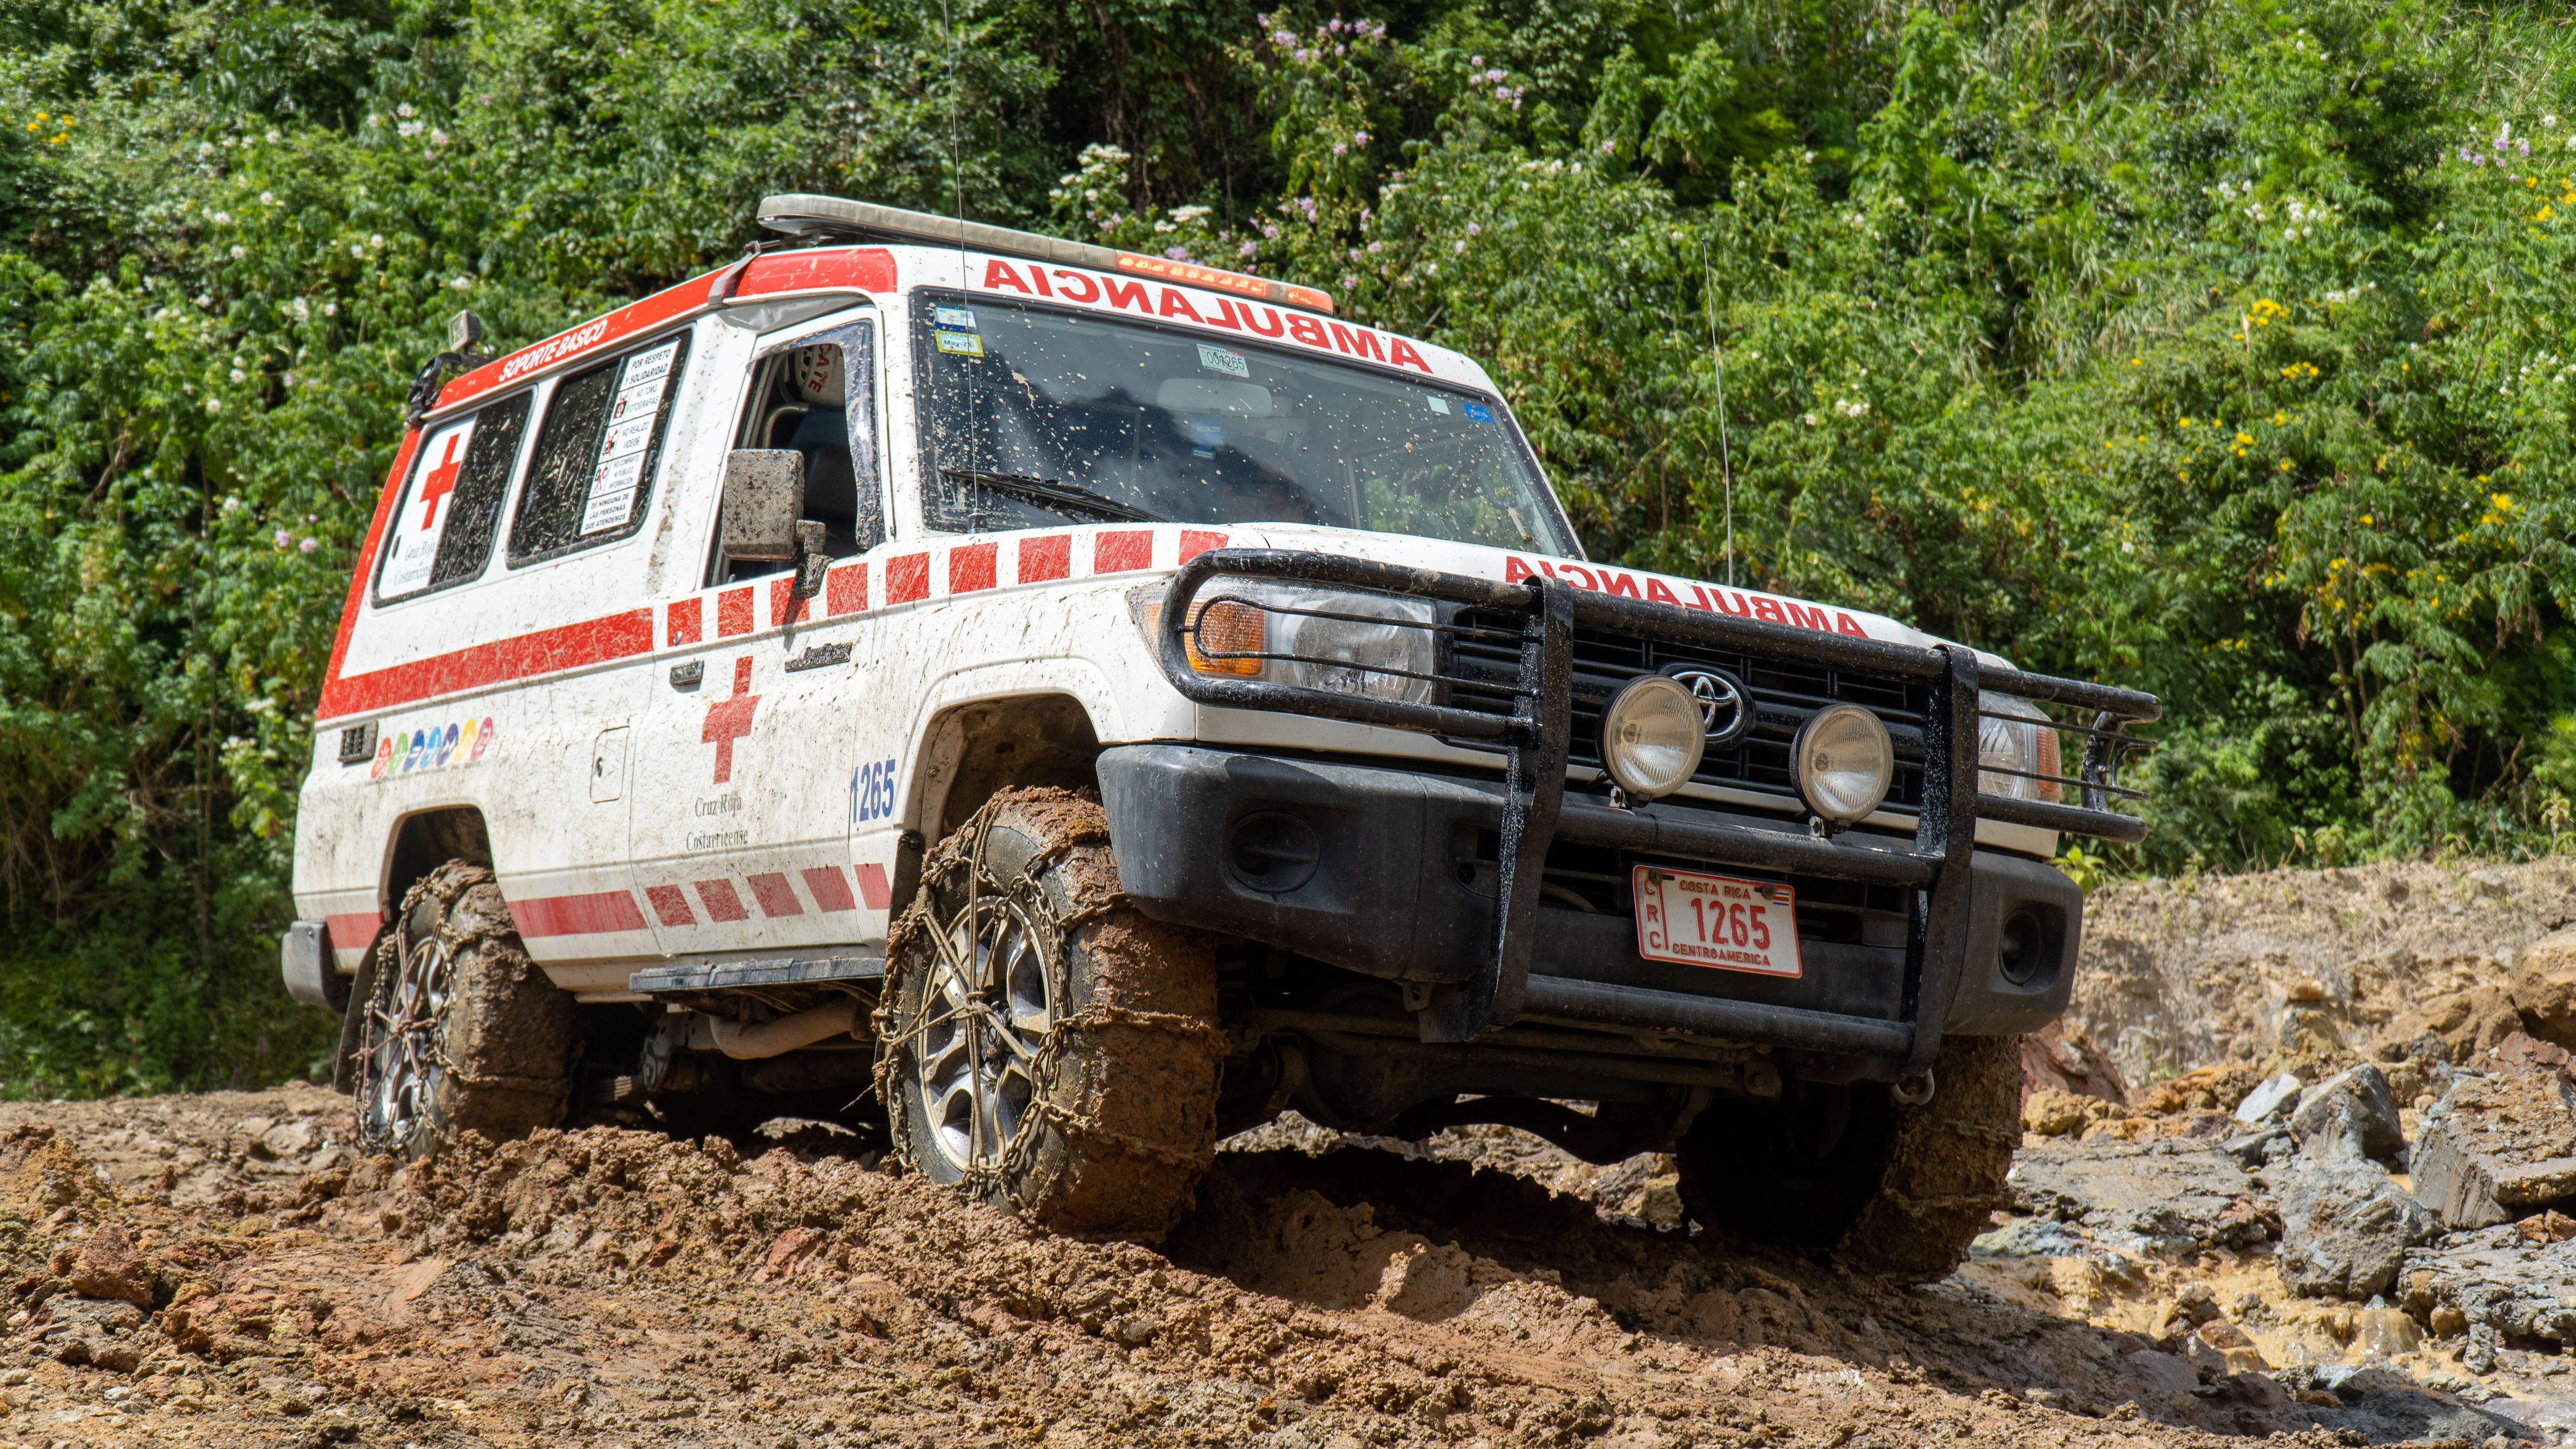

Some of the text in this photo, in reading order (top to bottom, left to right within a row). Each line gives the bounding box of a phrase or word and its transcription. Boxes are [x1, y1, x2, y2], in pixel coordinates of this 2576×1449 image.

[498, 319, 607, 382] SOPORTE BASICO
[631, 349, 671, 370] POR RESPETO
[625, 364, 668, 386] Y SOLIDARIDAD
[637, 384, 657, 397] NO TOMO
[627, 396, 659, 412] FOTOGRAFIAS
[622, 421, 649, 436] NO REALIZO
[623, 437, 640, 449] VIDEOS
[599, 496, 621, 507] NINGUNA
[599, 504, 626, 516] PERSONAS
[585, 514, 625, 530] QUE ATENDEMOS
[405, 538, 435, 560] Cruz Roja
[851, 759, 896, 823] 1265
[694, 792, 742, 817] Cruz Roja
[686, 829, 748, 851] Costarricense
[1679, 880, 1751, 900] COSTA RICA
[1689, 897, 1771, 950] 1265
[1672, 942, 1771, 966] CENTROAMERICA
